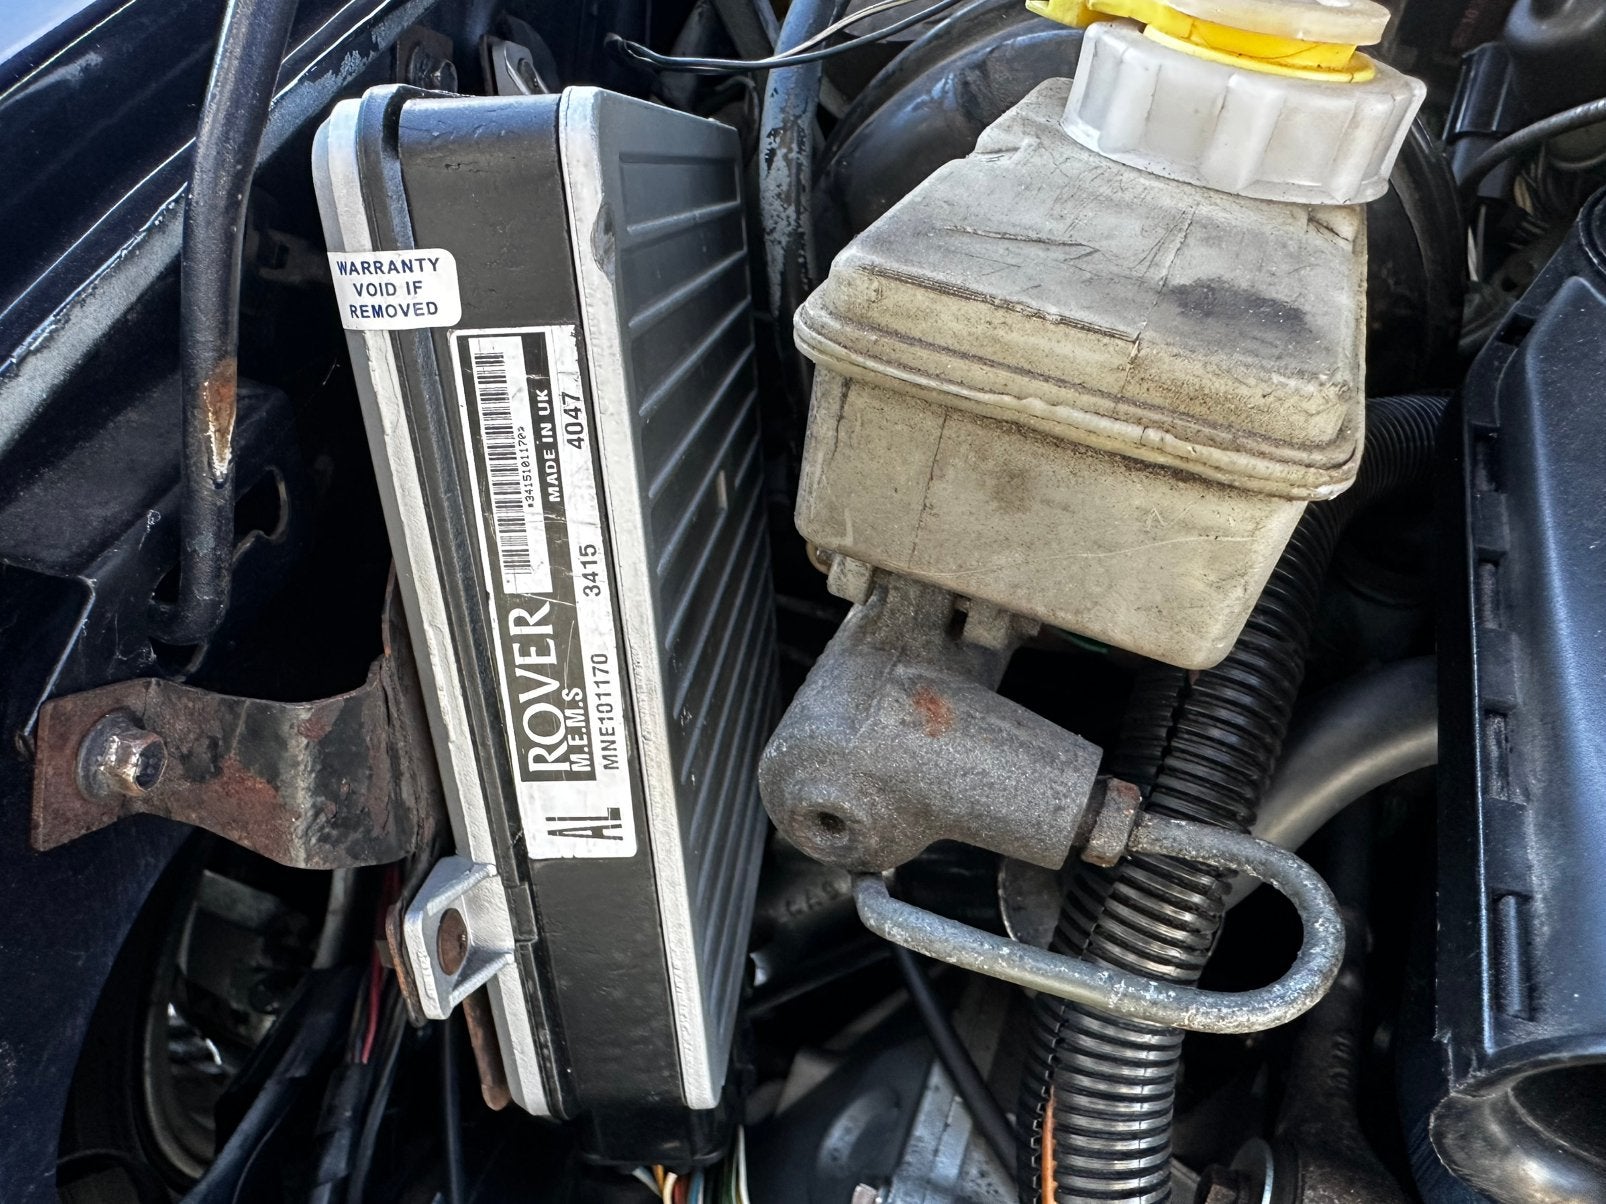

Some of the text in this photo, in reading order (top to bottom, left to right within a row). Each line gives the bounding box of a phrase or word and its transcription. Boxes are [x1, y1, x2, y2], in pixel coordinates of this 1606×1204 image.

[336, 257, 440, 275] WARRANTY
[353, 280, 423, 297] VOID IF
[349, 301, 438, 319] REMOVED
[535, 389, 561, 502] MADE IN UK
[561, 391, 620, 770] MNE101170 3415 4047
[507, 601, 571, 772] ROVER
[562, 687, 592, 772] M.E.M.S
[545, 807, 624, 841] AL
